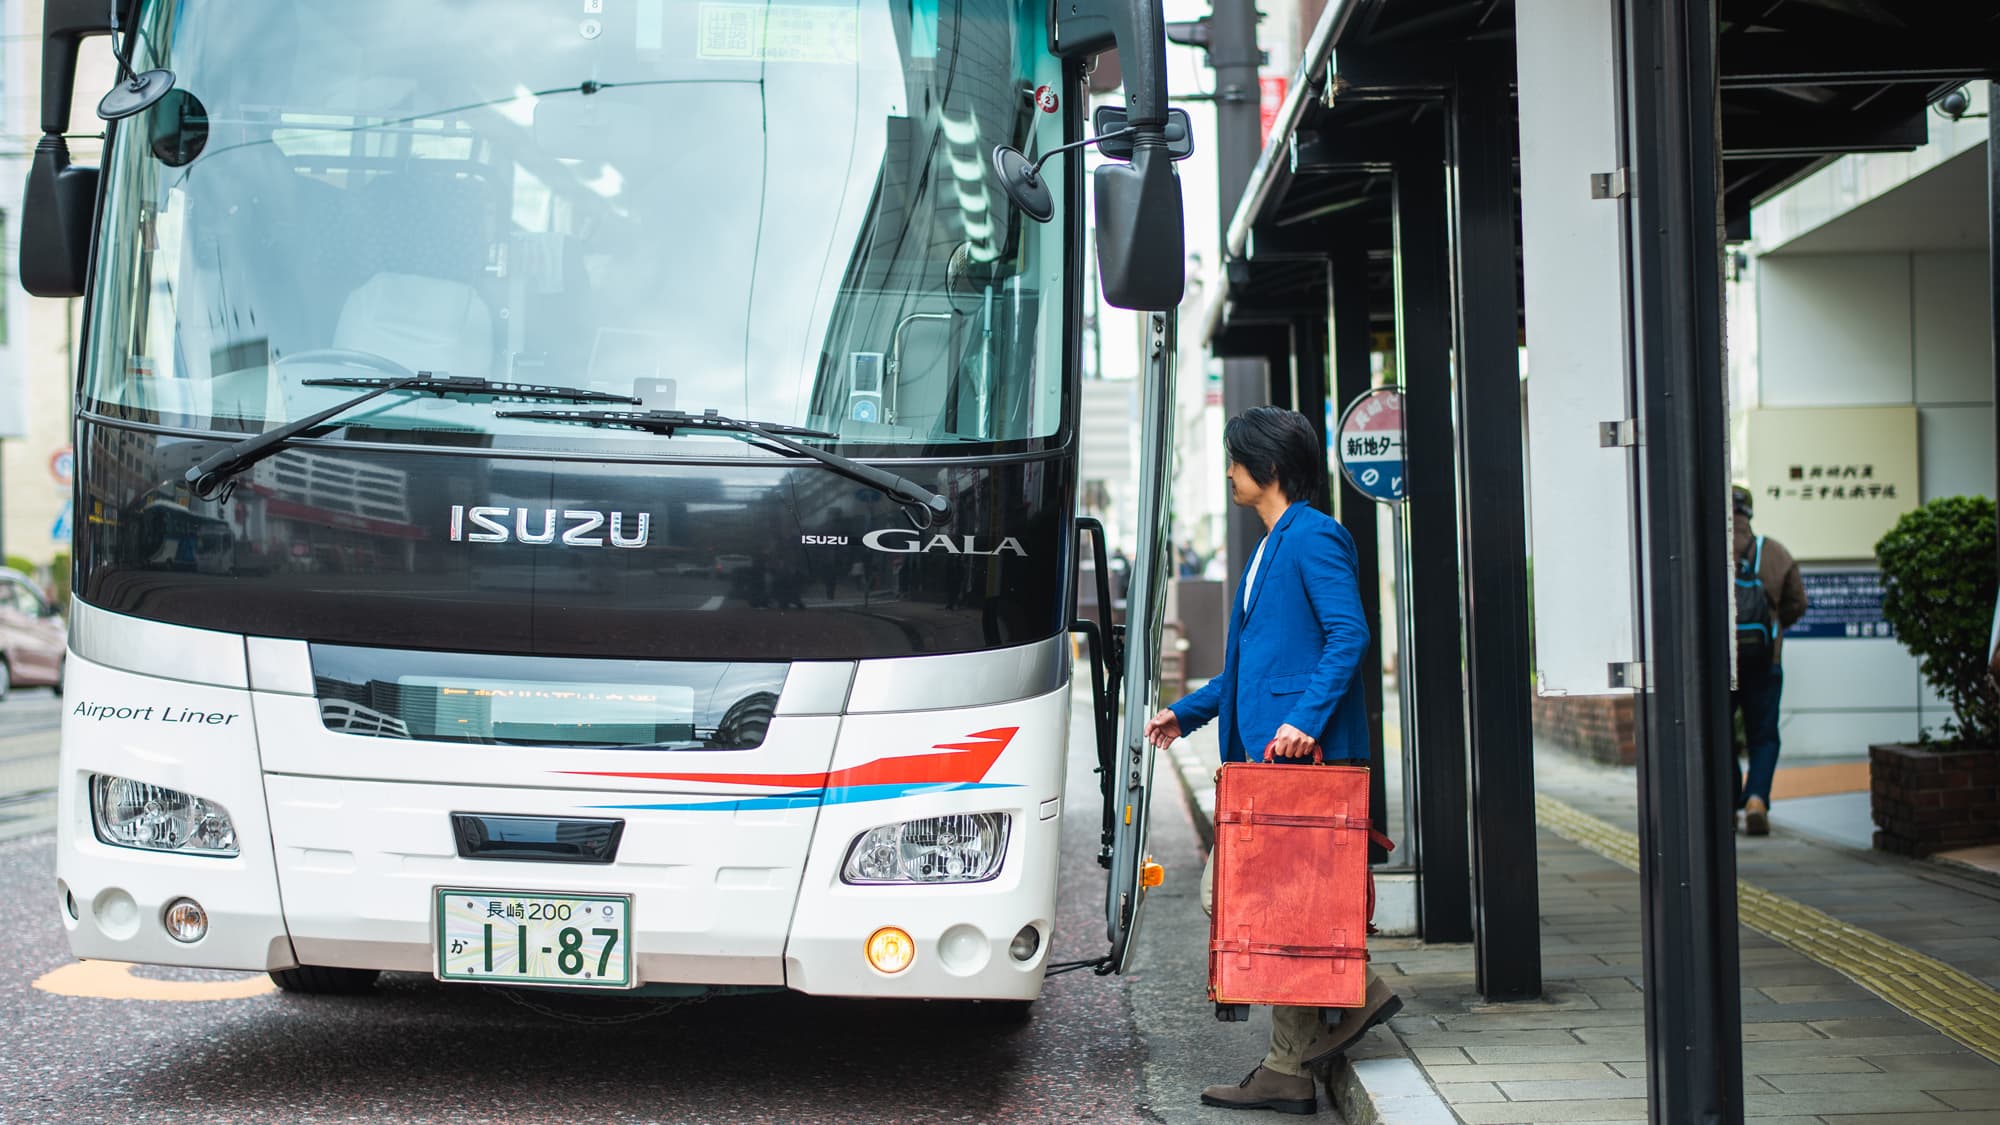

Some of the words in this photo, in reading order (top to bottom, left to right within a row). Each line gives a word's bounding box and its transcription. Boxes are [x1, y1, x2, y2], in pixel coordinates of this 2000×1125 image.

[1044, 95, 1051, 105] 2
[450, 505, 650, 549] ISUZU
[801, 535, 849, 546] ISUZU
[862, 528, 1029, 557] GALA
[73, 700, 155, 721] Airport
[161, 706, 239, 726] Liner
[450, 938, 469, 955] か
[483, 923, 619, 977] 11-87
